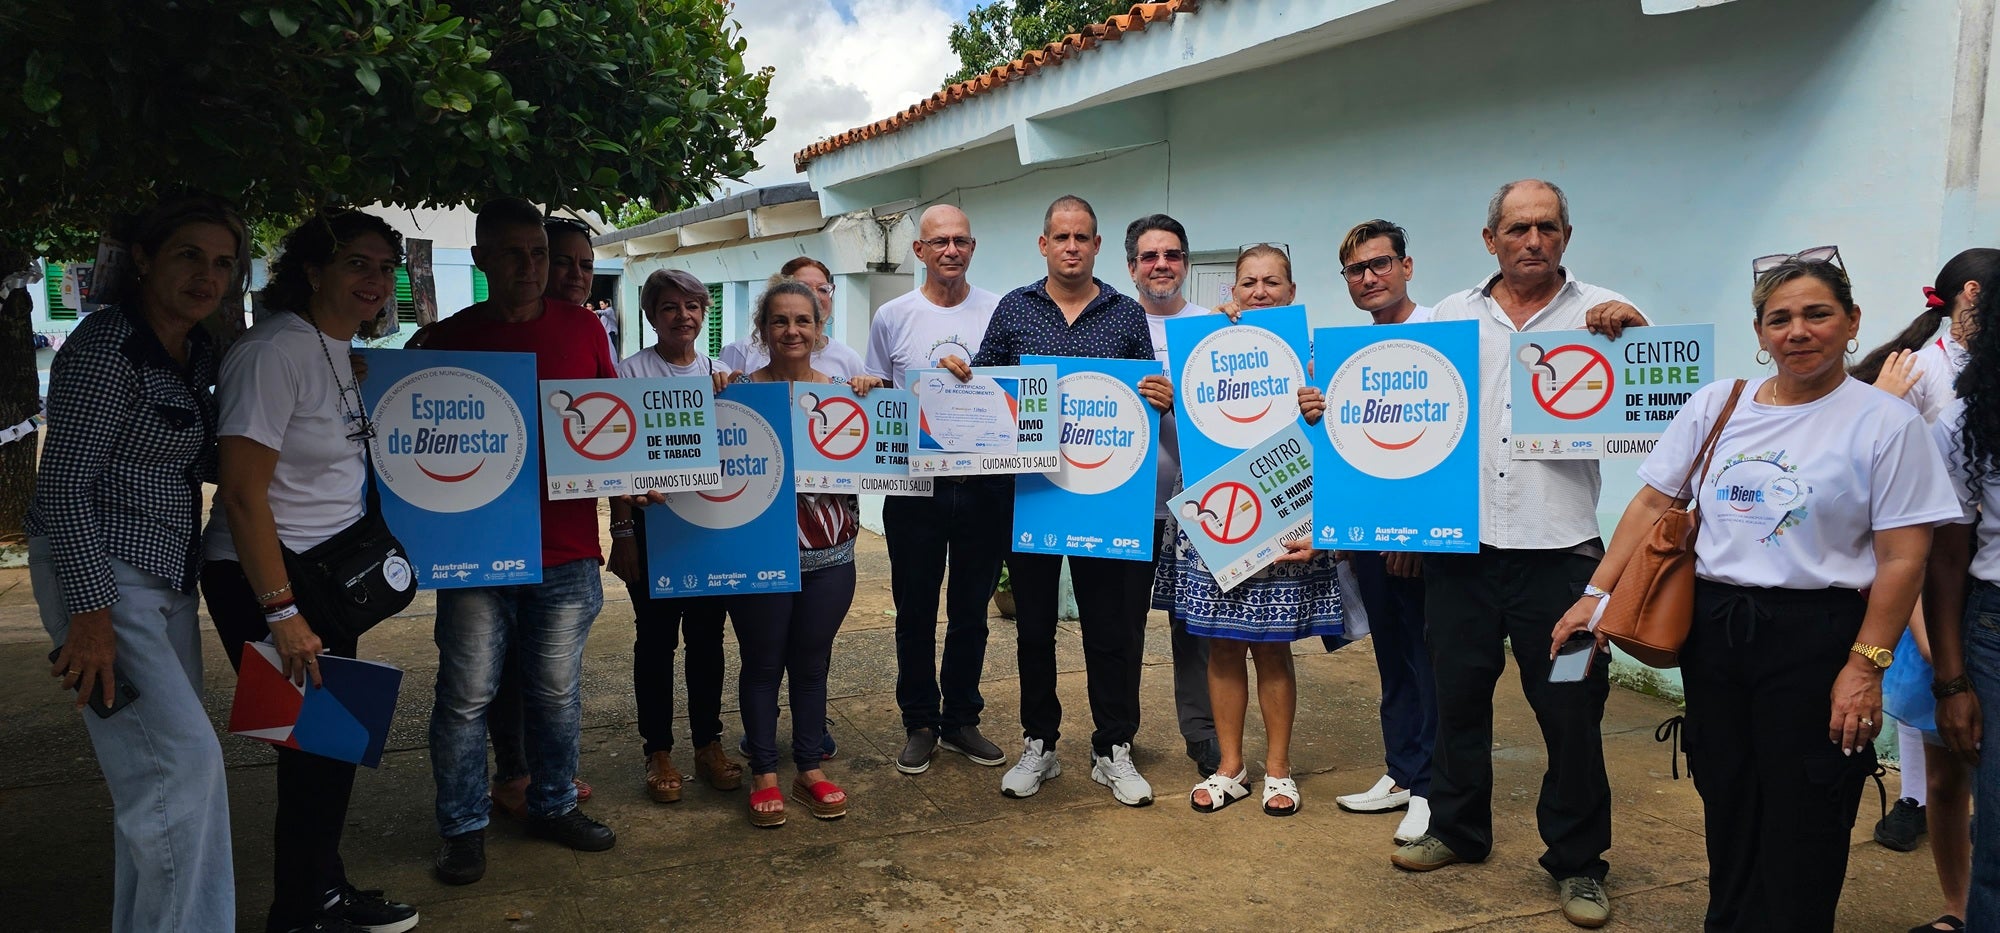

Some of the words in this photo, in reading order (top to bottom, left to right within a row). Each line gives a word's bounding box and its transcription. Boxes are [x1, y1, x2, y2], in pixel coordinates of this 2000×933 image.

[1387, 344, 1420, 352] MUNICIPIOS
[1624, 340, 1700, 364] CENTRO
[1210, 346, 1270, 376] Espacio
[1420, 348, 1446, 367] CIUDADES
[1362, 364, 1428, 396] Espacio
[1624, 366, 1700, 385] LIBRE
[392, 372, 429, 396] MOVIMIENTO
[476, 377, 504, 397] CIUDADES
[1020, 378, 1048, 396] TRO
[1446, 368, 1464, 408] COMUNIDADES
[386, 394, 394, 406] DEL
[642, 389, 704, 410] CENTRO
[1060, 393, 1118, 422] Espacio
[1626, 394, 1644, 406] DE
[412, 393, 485, 426] Espacio
[876, 400, 908, 419] CENT
[1626, 410, 1640, 421] DE
[1644, 410, 1679, 420] TABA
[504, 399, 524, 440] COMUNIDADES
[644, 411, 704, 428] LIBRE
[1018, 420, 1043, 430] UMO
[716, 423, 748, 446] acio
[876, 421, 908, 436] LIB
[1060, 422, 1135, 448] Bienestar
[646, 435, 662, 447] DE
[666, 434, 702, 446] HUMO
[1018, 433, 1042, 442] BACO
[1331, 428, 1344, 450] CENTRO
[1446, 431, 1458, 449] SALUD
[648, 450, 661, 460] DE
[664, 448, 701, 459] TABACO
[876, 442, 888, 452] DE
[876, 456, 886, 464] DE
[888, 456, 908, 465] TABA
[982, 457, 1021, 470] CUIDAMOS
[1022, 457, 1032, 468] TU
[1034, 456, 1058, 468] SALUD
[1249, 438, 1302, 479] CENTRO
[376, 458, 394, 482] CENTRO
[506, 463, 518, 480] SALUD
[1258, 454, 1312, 495] LIBRE
[634, 475, 678, 490] CUIDAMOS
[680, 474, 692, 487] TU
[692, 472, 719, 486] SALUD
[862, 478, 898, 490] CUIDAMOS
[898, 480, 908, 490] TU
[910, 480, 932, 492] SALUD
[1270, 494, 1286, 508] DE
[1278, 506, 1290, 518] DE
[1066, 534, 1103, 543] Australian
[1430, 528, 1464, 538] OPS
[1112, 538, 1140, 548] OPS
[1256, 546, 1271, 558] OPS
[432, 562, 479, 572] Australian
[492, 559, 526, 571] OPS
[432, 571, 448, 580] Aid
[708, 572, 748, 580] Australian
[757, 570, 786, 580] OPS
